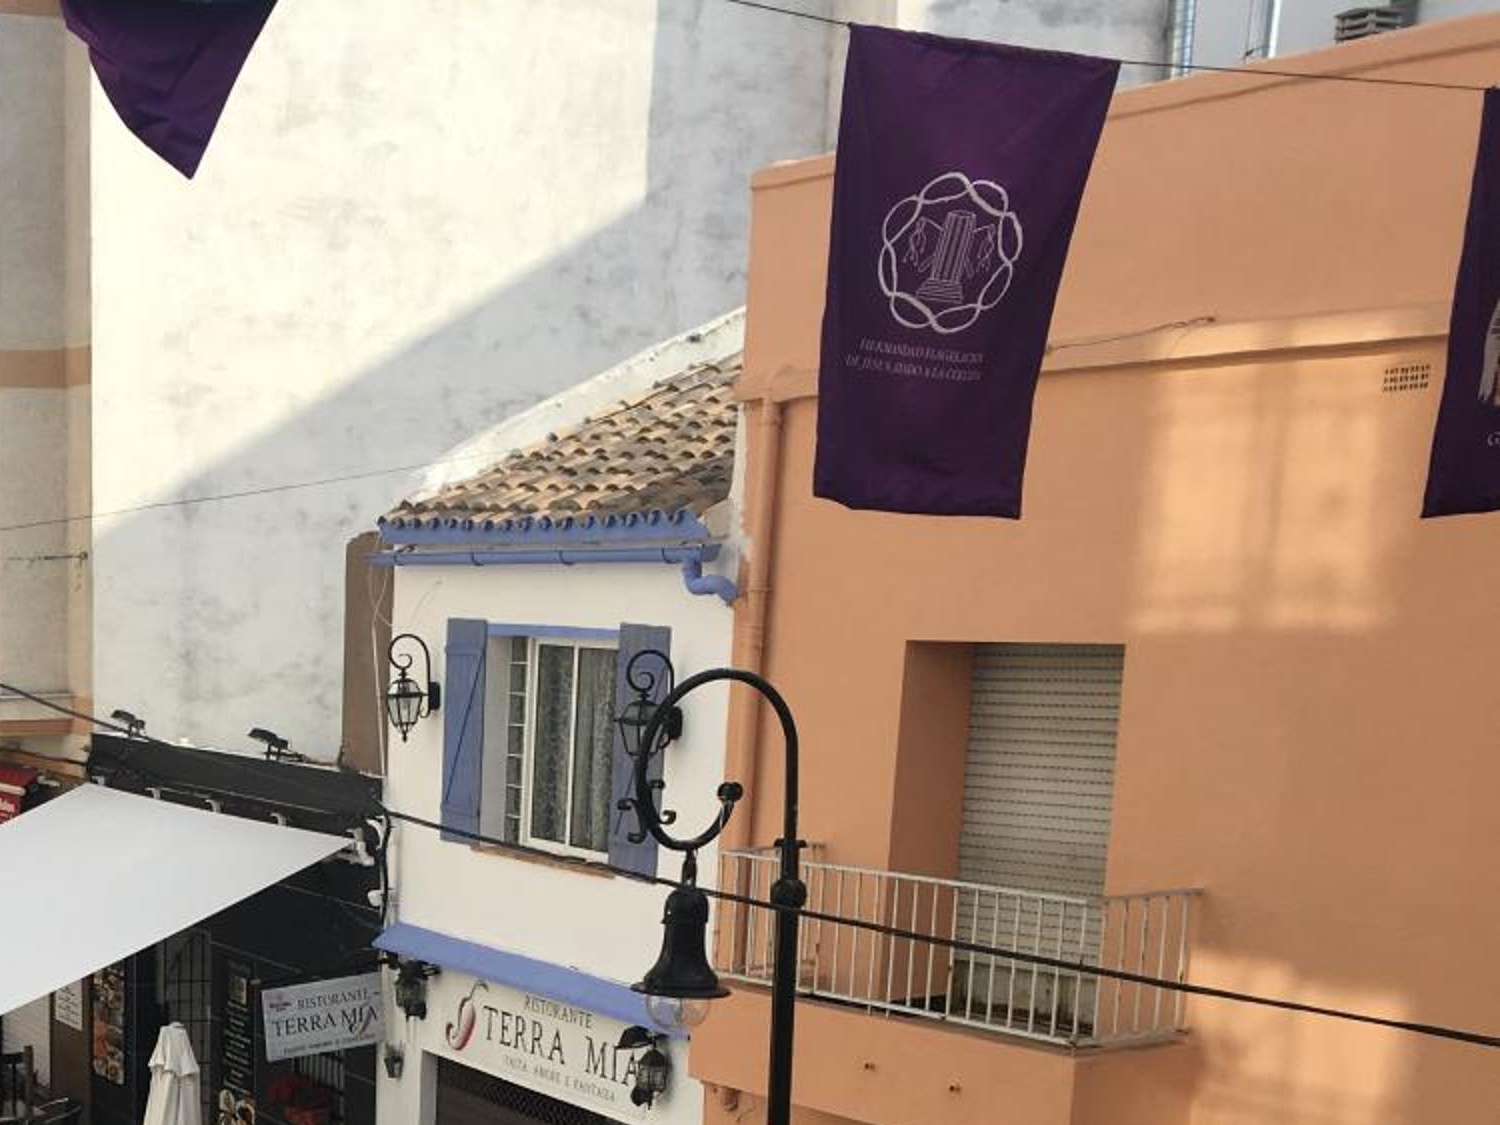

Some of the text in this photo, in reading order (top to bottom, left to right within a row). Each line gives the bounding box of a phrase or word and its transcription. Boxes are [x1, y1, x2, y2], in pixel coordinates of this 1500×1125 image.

[297, 988, 370, 1010] RISTORANTE
[523, 994, 594, 1030] RISTORANTE
[272, 1012, 336, 1037] TERRA
[483, 1005, 641, 1087] TERRA MIA
